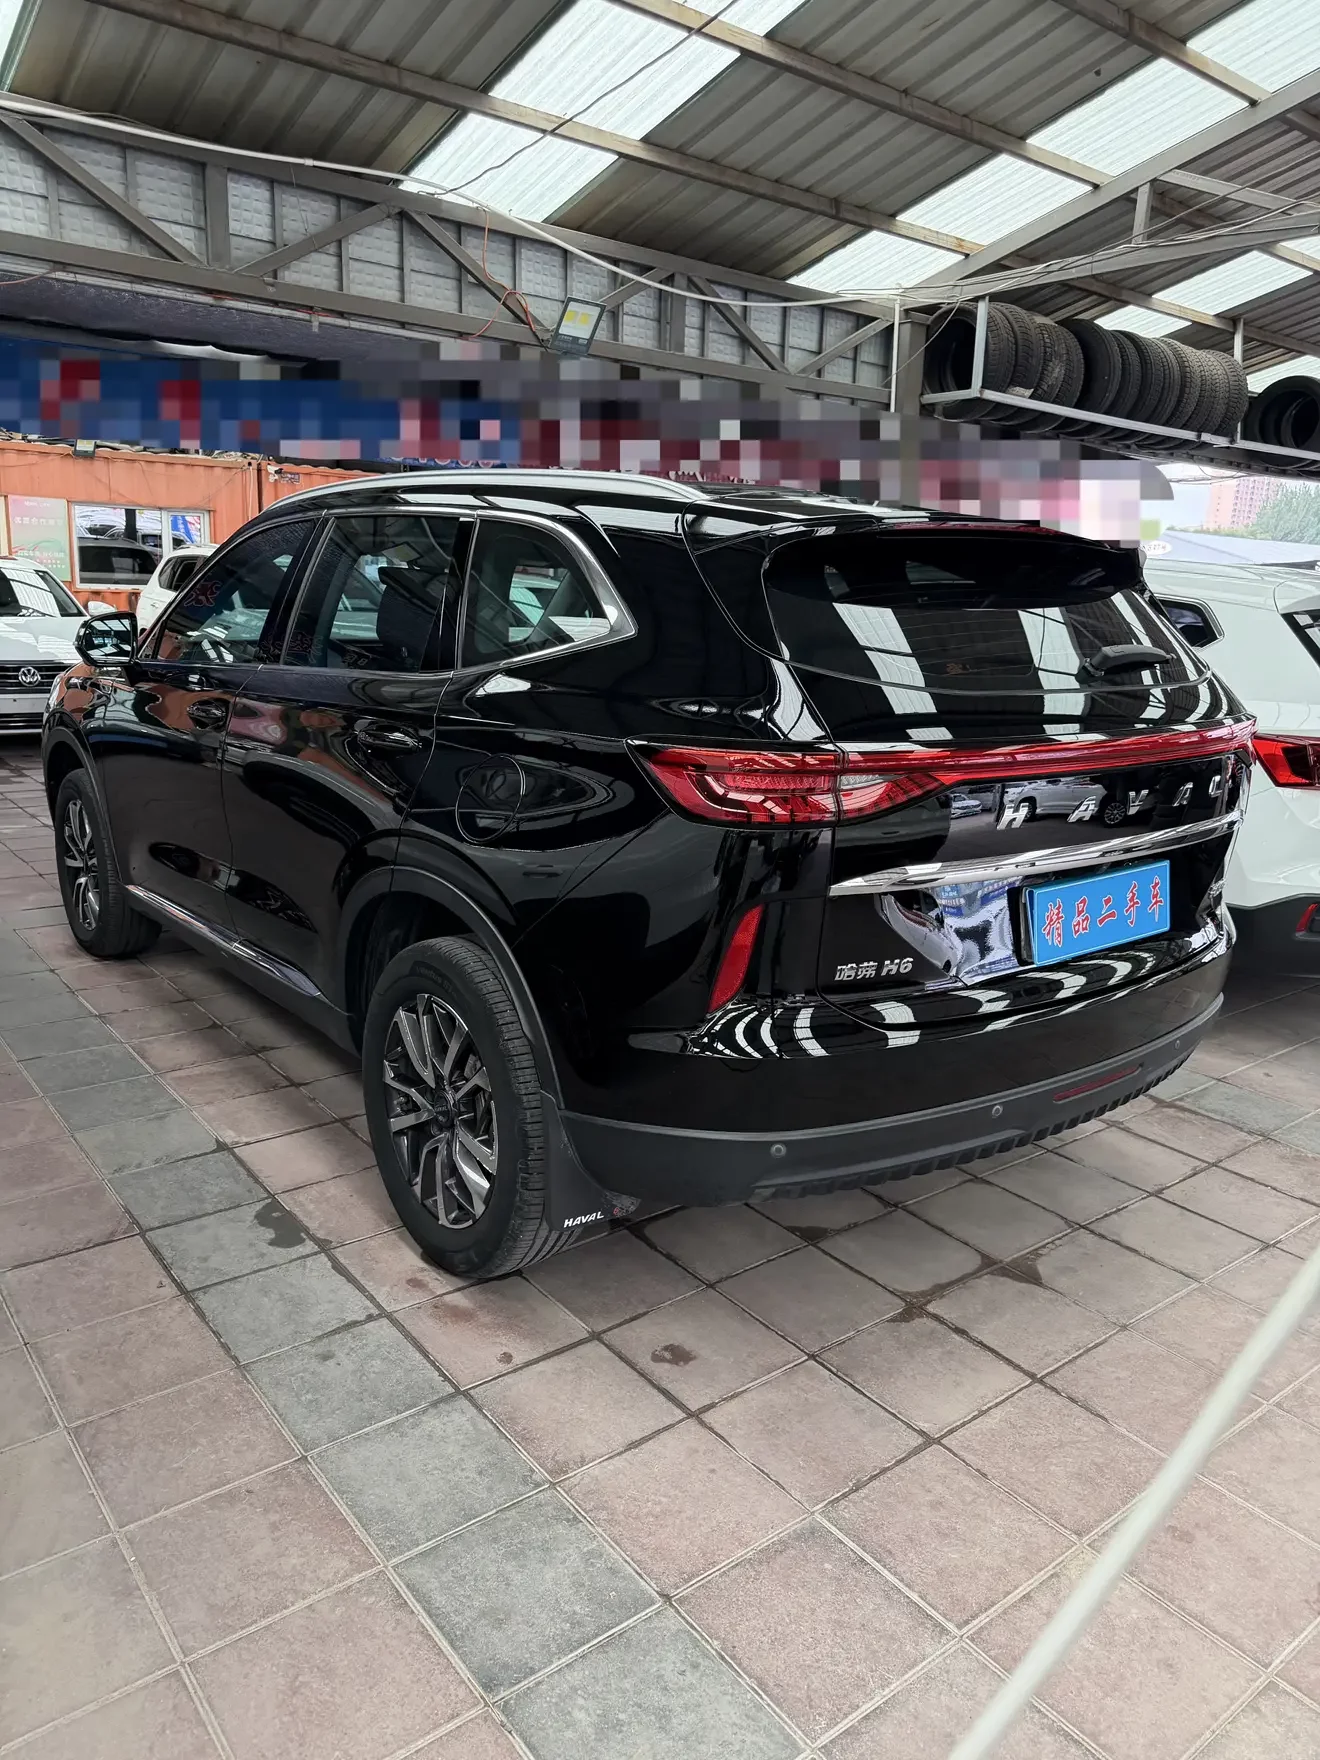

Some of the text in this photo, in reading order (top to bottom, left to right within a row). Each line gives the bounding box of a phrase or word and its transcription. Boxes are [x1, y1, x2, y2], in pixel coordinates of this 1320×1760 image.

[997, 775, 1223, 830] HAVAL
[1042, 875, 1164, 947] 精品二手车
[834, 957, 914, 981] 哈弗 H6
[563, 1211, 605, 1228] HAVAL
